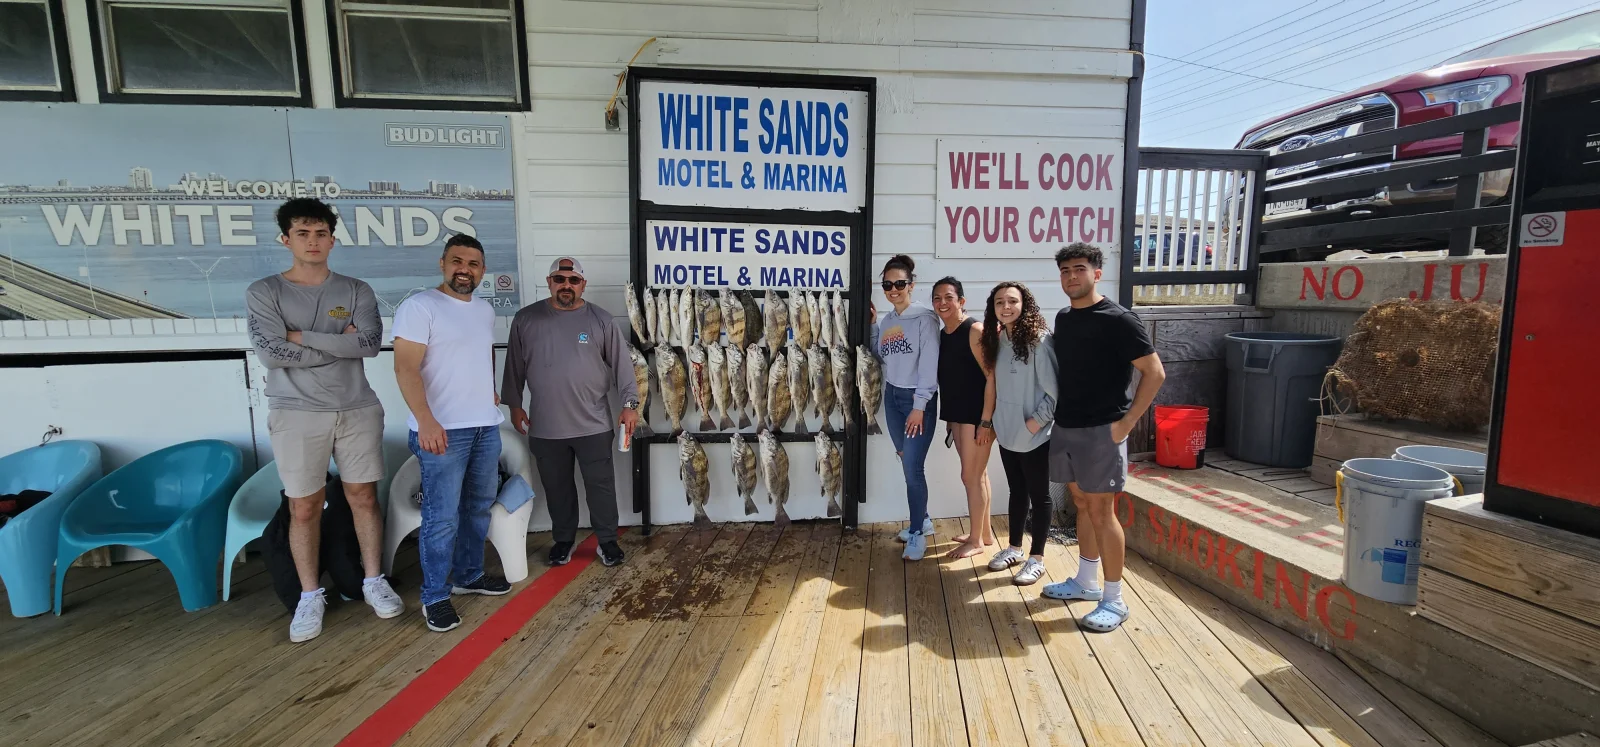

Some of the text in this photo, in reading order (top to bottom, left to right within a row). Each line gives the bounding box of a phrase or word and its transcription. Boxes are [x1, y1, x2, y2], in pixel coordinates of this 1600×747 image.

[389, 127, 499, 145] BUD LIGHT
[657, 92, 849, 158] WHITE SANDS
[181, 180, 341, 198] WELCOME TO
[658, 157, 848, 194] MOTEL & MARINA
[948, 151, 1115, 191] WE'LL COOK
[41, 204, 478, 247] WHITE ANDS
[653, 225, 846, 256] WHITE SANDS
[944, 205, 1115, 244] YOUR CATCH
[654, 264, 844, 288] MOTEL & MARINA
[1298, 262, 1502, 302] NO JU
[1394, 538, 1421, 549] REG
[1146, 505, 1358, 641] SMOKING
